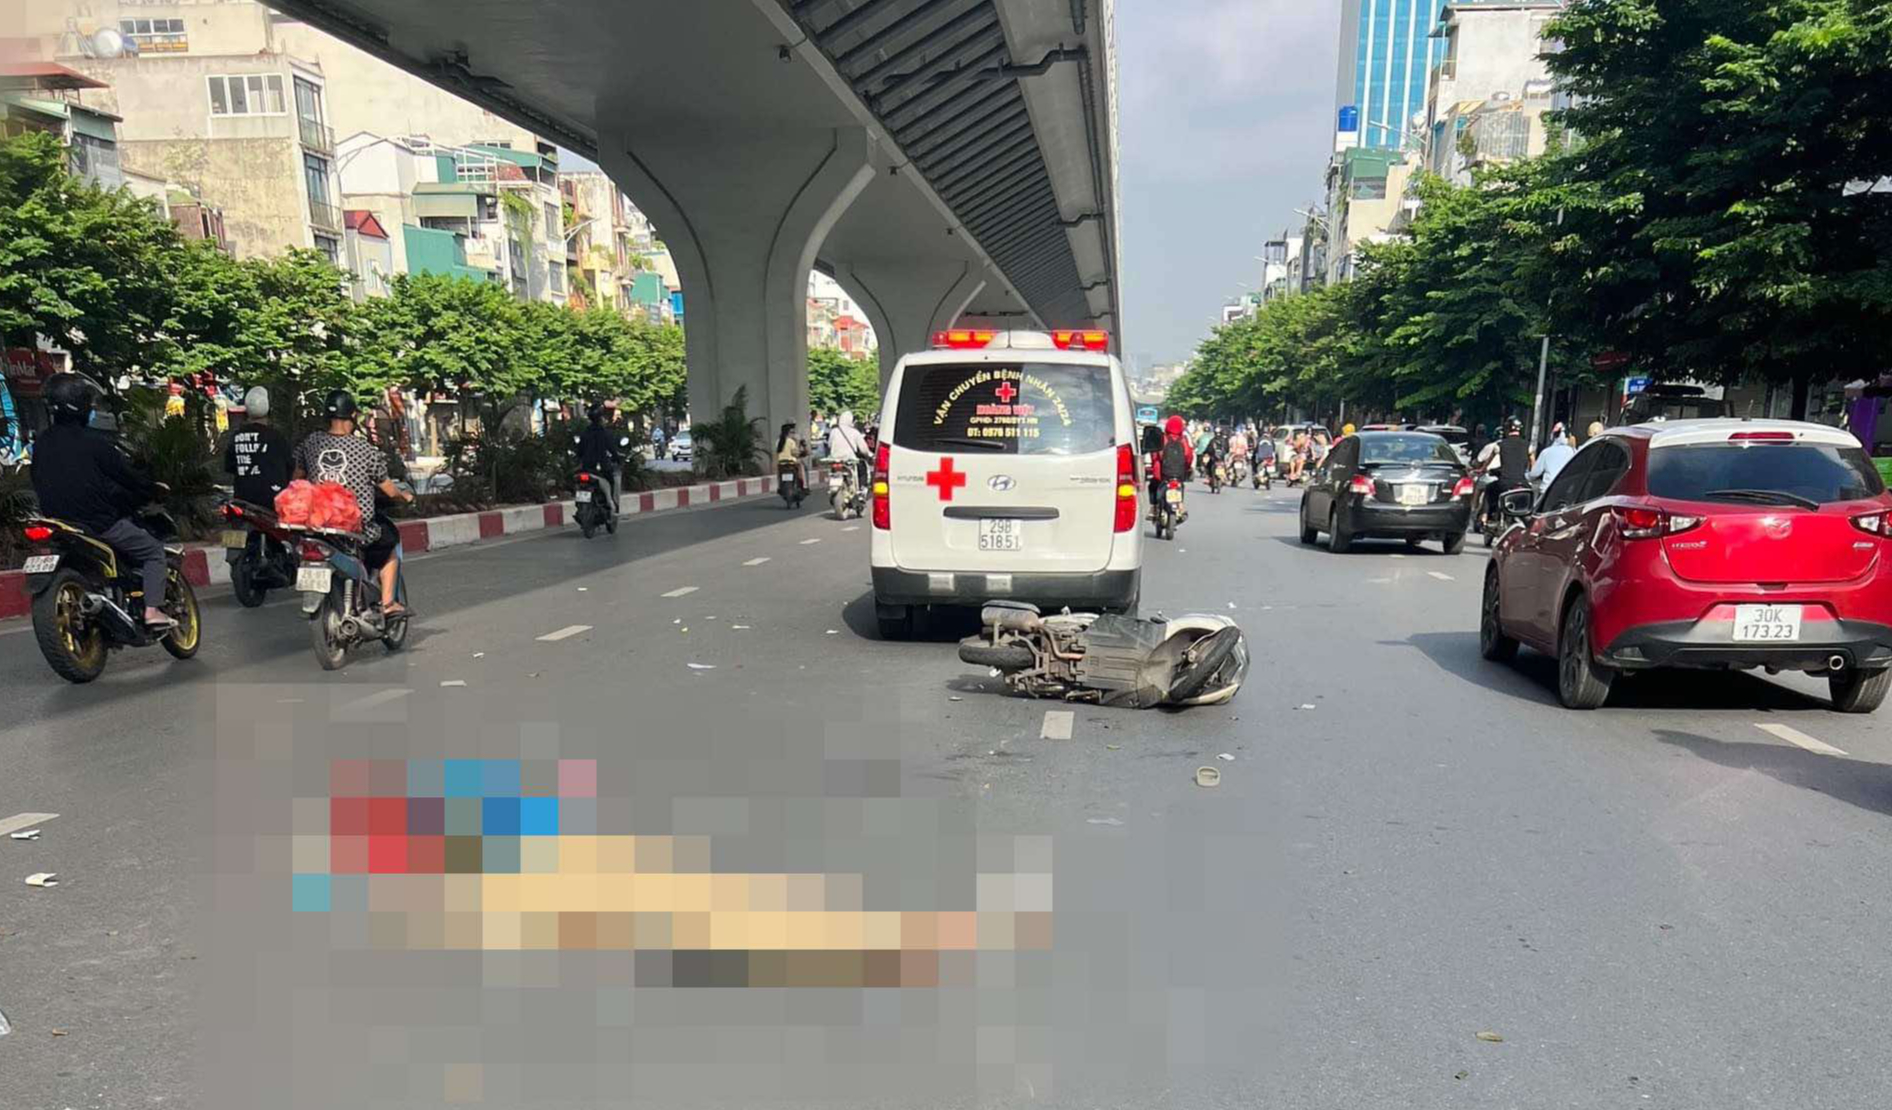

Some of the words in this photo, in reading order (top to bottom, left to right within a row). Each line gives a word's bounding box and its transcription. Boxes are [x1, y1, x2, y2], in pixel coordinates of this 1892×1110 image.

[993, 368, 1024, 381] BỆNH
[989, 519, 1012, 534] 29B
[1754, 608, 1783, 623] 30K
[1743, 624, 1794, 639] 173.23
